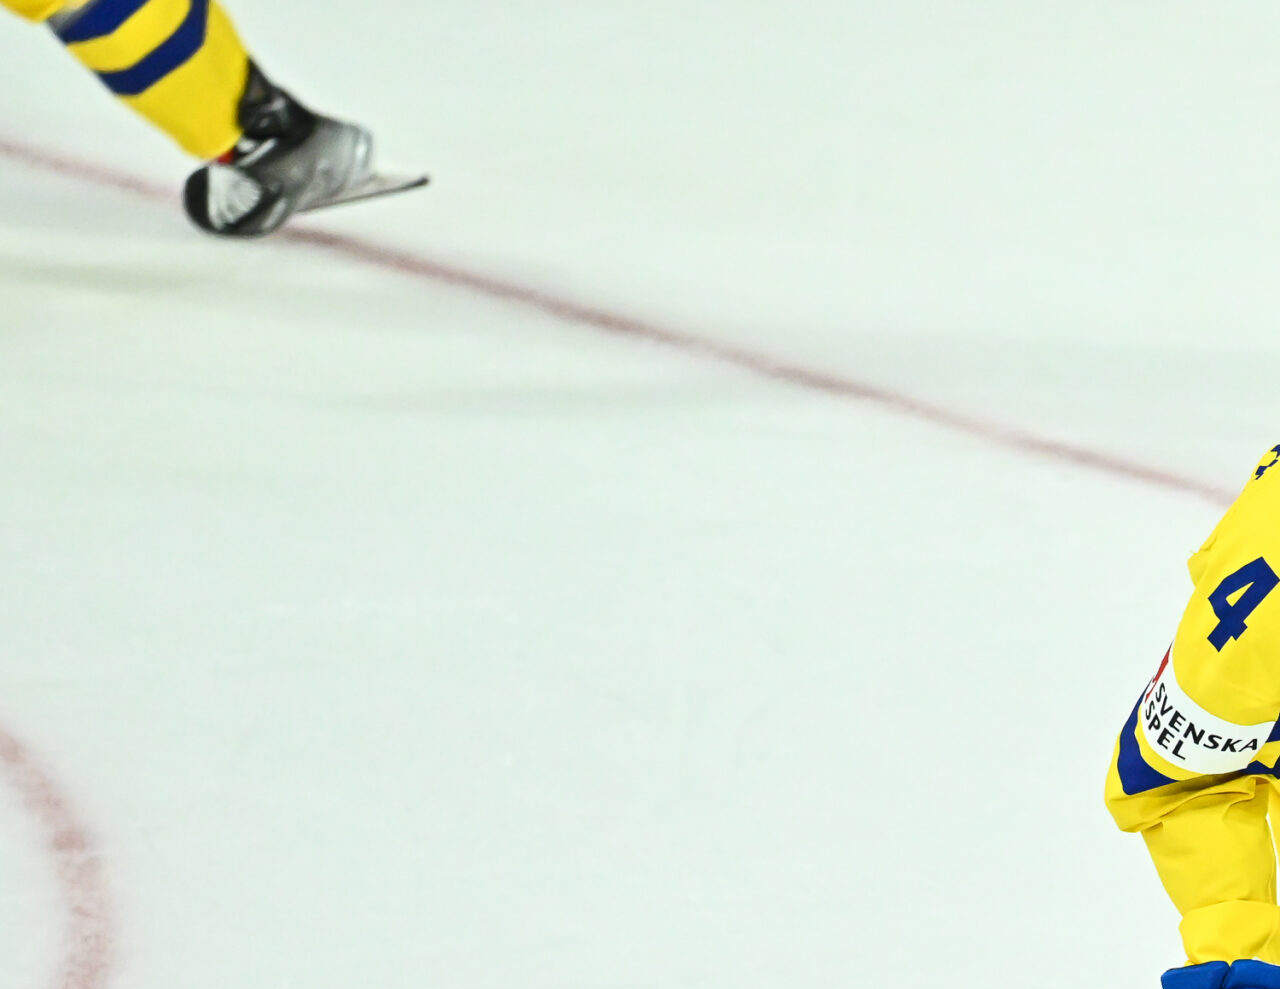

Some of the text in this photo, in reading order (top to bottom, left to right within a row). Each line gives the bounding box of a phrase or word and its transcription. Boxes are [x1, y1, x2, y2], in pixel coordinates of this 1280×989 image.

[1207, 556, 1280, 653] 4
[1145, 700, 1187, 760] SPEL
[1155, 682, 1258, 753] SVENSKA
